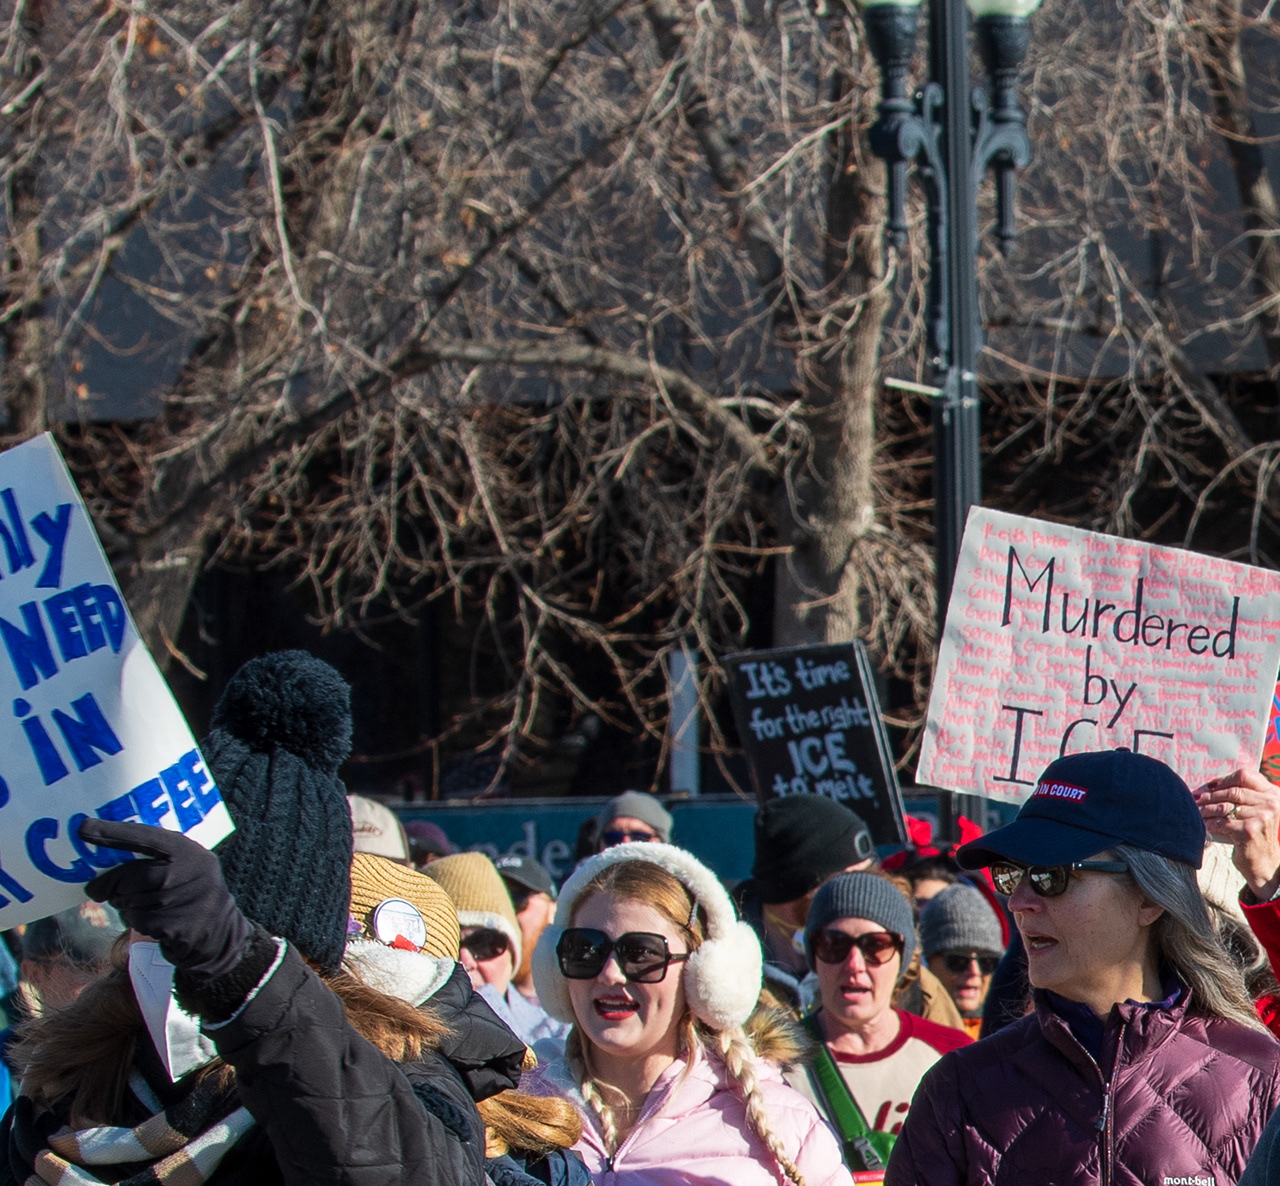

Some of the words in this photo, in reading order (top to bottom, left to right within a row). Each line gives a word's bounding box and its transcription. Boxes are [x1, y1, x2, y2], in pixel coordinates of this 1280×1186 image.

[1002, 544, 1240, 661] Murdered
[739, 661, 793, 700] It's
[794, 656, 851, 692] time
[1082, 644, 1138, 730] by
[749, 705, 785, 742] for
[820, 696, 871, 731] right
[787, 730, 857, 778] ICE
[1050, 784, 1087, 802] COURT
